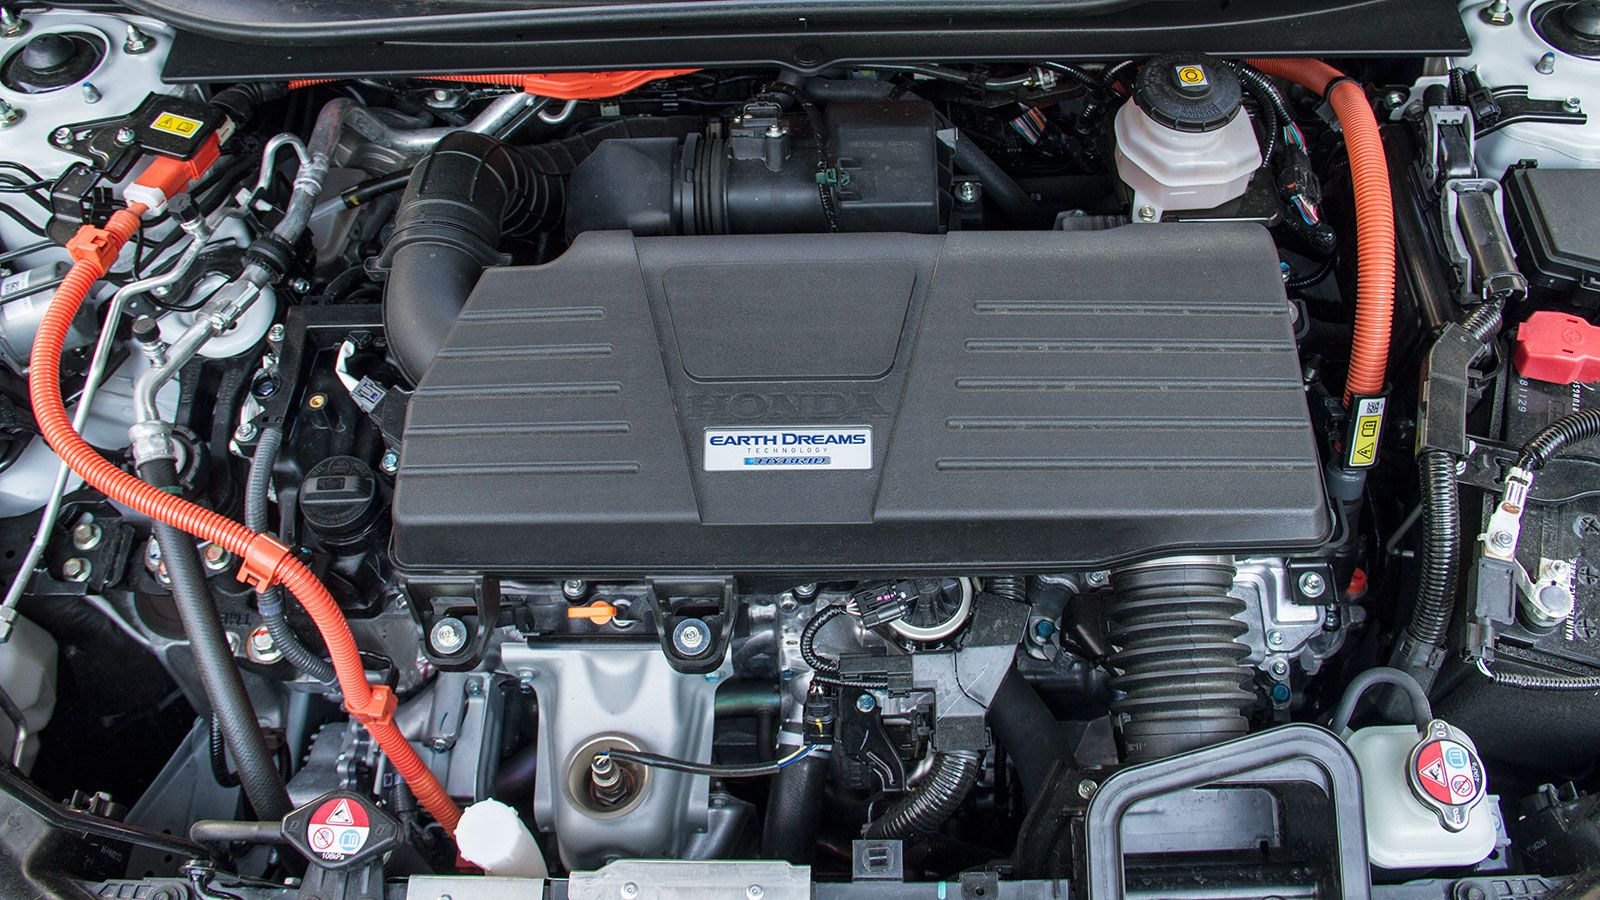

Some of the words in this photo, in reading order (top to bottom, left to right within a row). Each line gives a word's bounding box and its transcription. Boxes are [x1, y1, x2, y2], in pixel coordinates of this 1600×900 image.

[686, 392, 890, 419] HONDA
[709, 435, 777, 446] EARTH
[782, 433, 866, 445] DREAMS
[1435, 722, 1446, 738] 0.5
